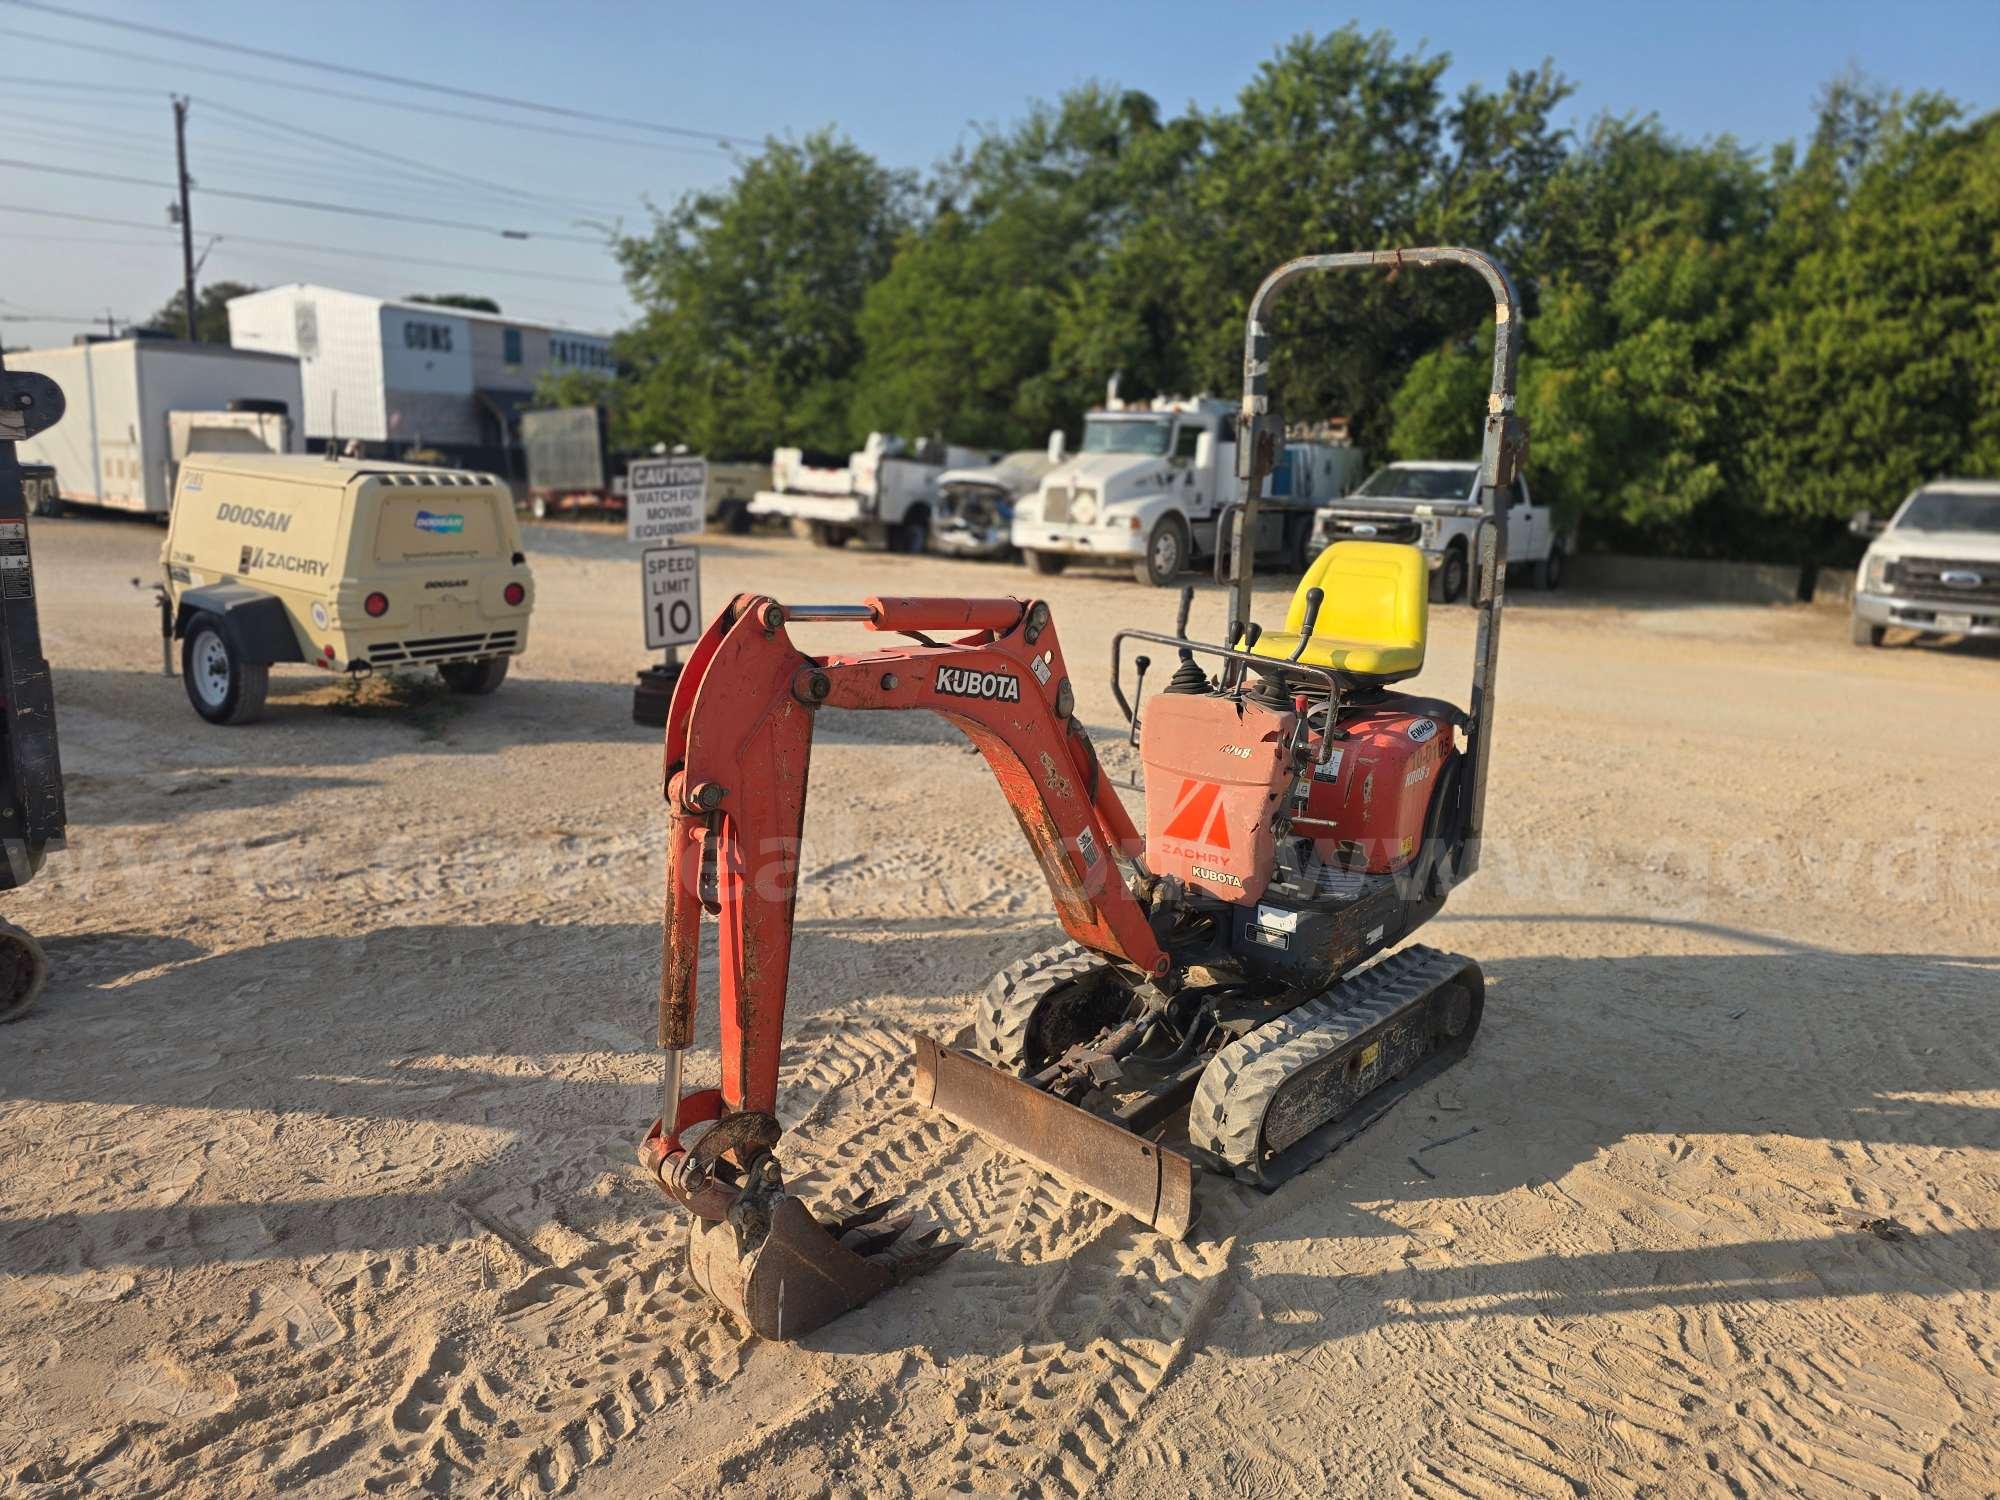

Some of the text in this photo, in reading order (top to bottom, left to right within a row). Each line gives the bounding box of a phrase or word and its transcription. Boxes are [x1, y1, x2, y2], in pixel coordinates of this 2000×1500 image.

[403, 320, 453, 354] GUNS
[635, 466, 702, 486] CAUTION
[635, 488, 700, 504] WATCH FOR
[216, 502, 292, 533] DOOSAN
[415, 517, 464, 528] DOOSAN
[647, 505, 693, 520] MOVING
[636, 520, 700, 538] EQUIPMENT
[266, 552, 329, 577] ZACHRY
[648, 557, 695, 574] SPEED
[653, 578, 691, 595] LIMIT
[654, 600, 692, 637] 10
[936, 667, 1020, 701] KUBOTA
[1410, 720, 1434, 739] EWALD
[1161, 843, 1230, 866] ZACHRY
[1192, 866, 1243, 888] KUBOTA
